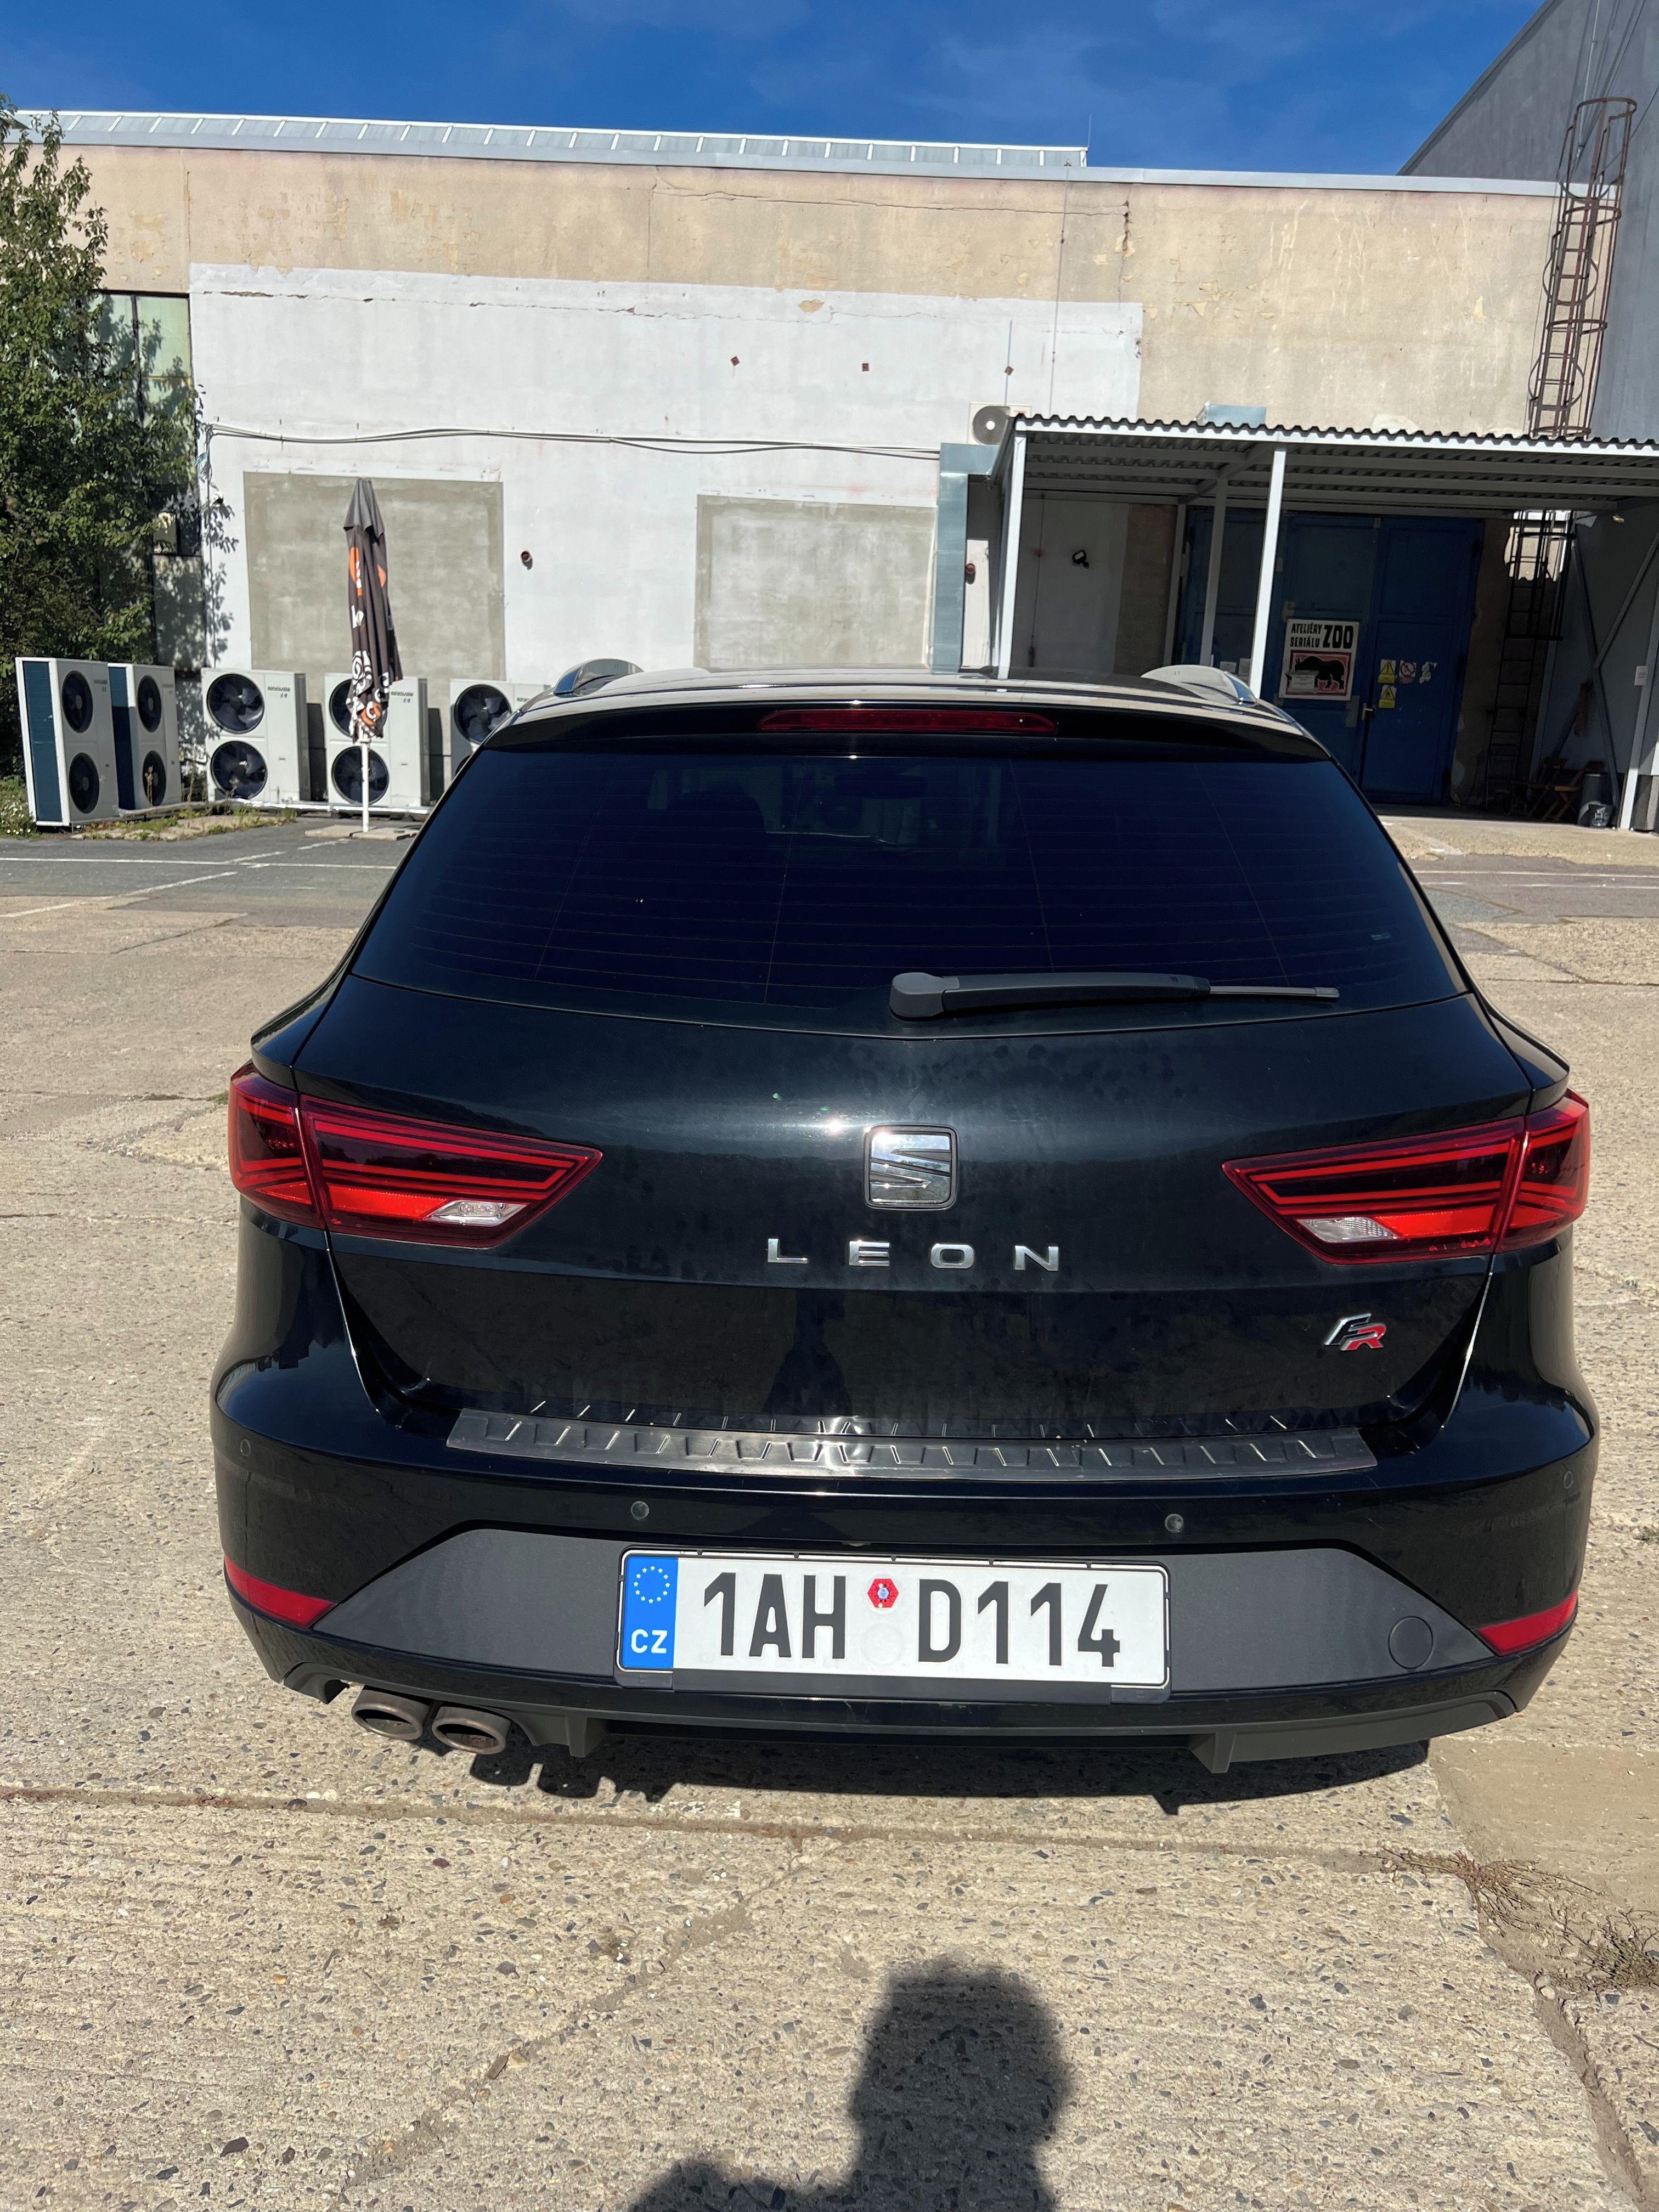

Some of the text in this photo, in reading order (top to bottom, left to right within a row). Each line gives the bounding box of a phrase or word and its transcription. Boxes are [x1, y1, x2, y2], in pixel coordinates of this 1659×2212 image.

[1291, 622, 1322, 634] ATELIÉRY
[1323, 624, 1354, 649] ZOO
[1290, 636, 1321, 648] SERIÁLU
[768, 1238, 1059, 1272] LEON
[1323, 1312, 1387, 1351] FR
[631, 1628, 668, 1654] CZ
